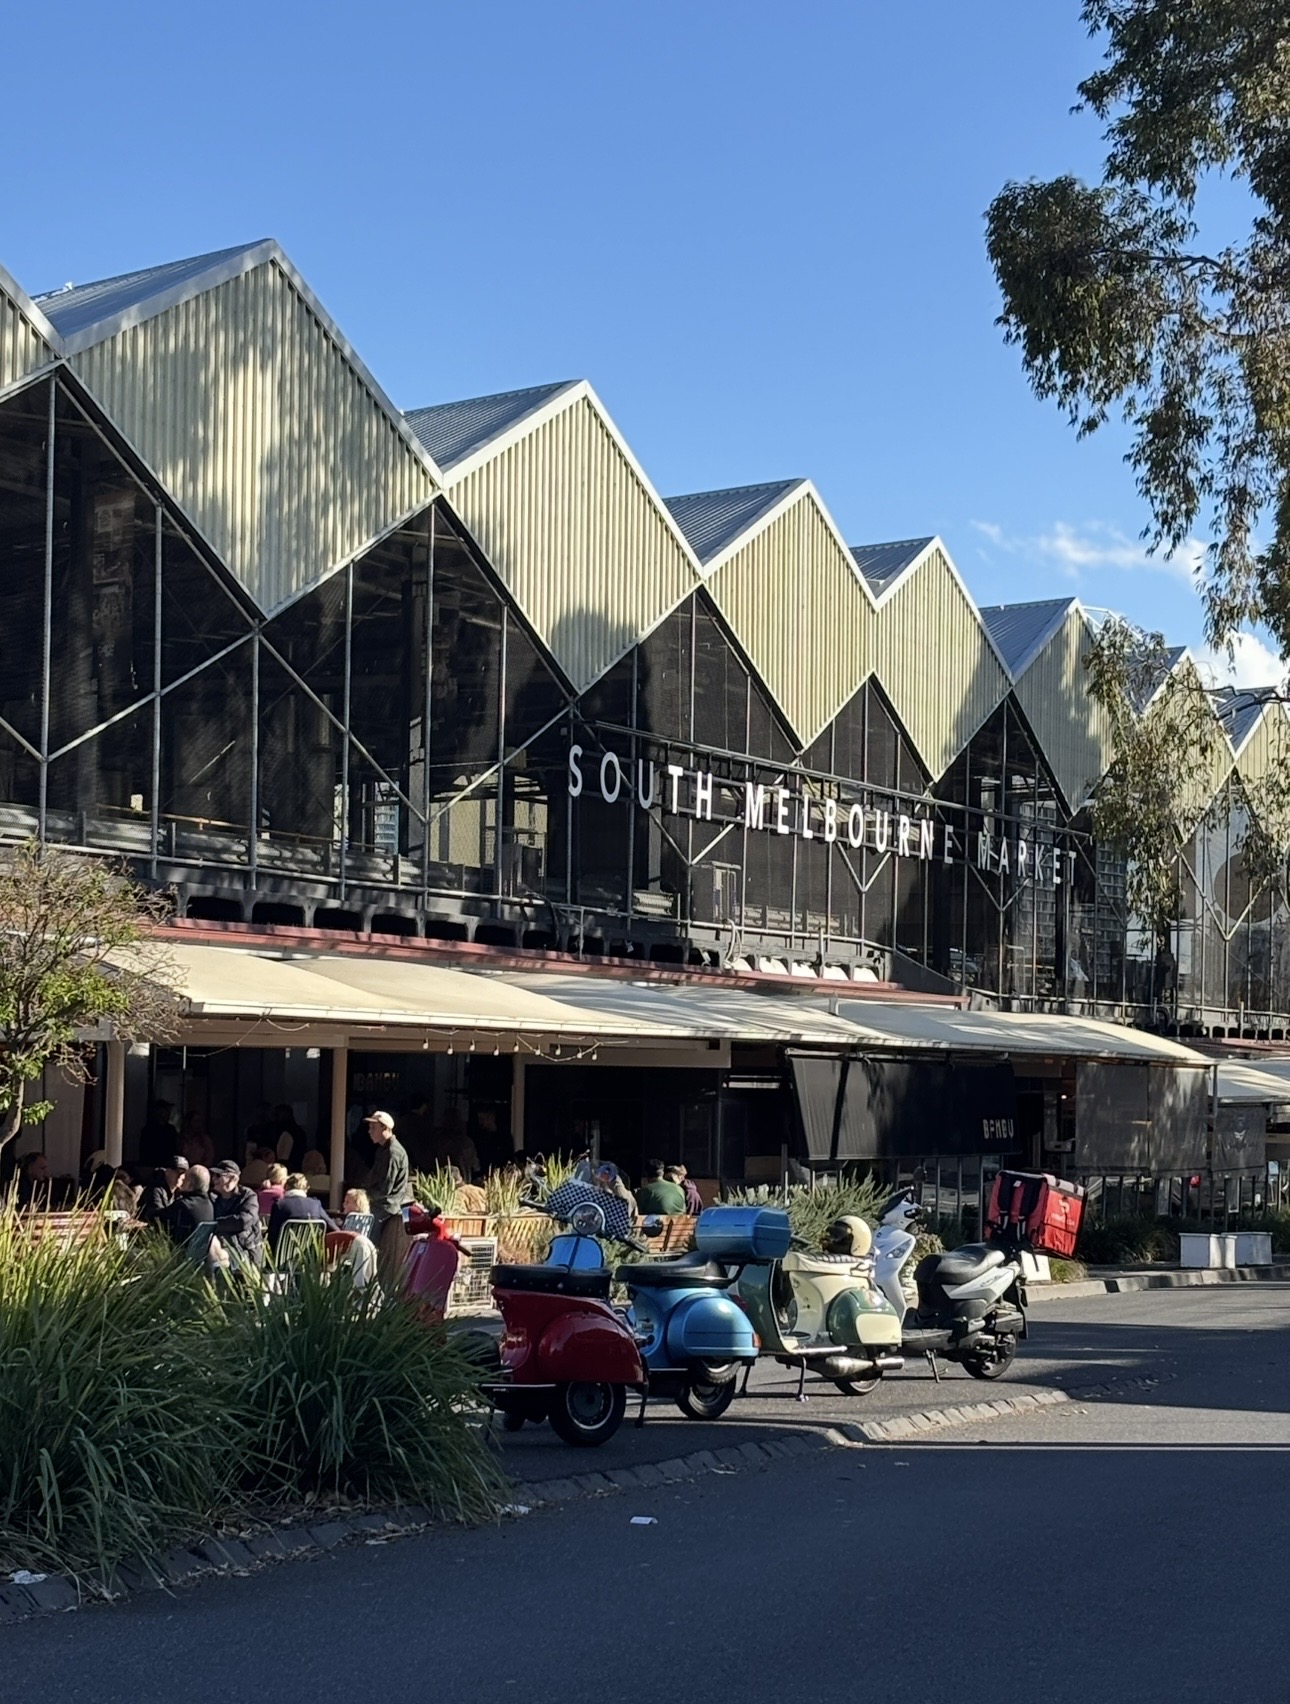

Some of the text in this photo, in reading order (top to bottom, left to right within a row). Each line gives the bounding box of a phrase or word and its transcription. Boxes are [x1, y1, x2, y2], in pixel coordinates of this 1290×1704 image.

[568, 744, 1077, 886] SOUTH MELBOURNE MARKET
